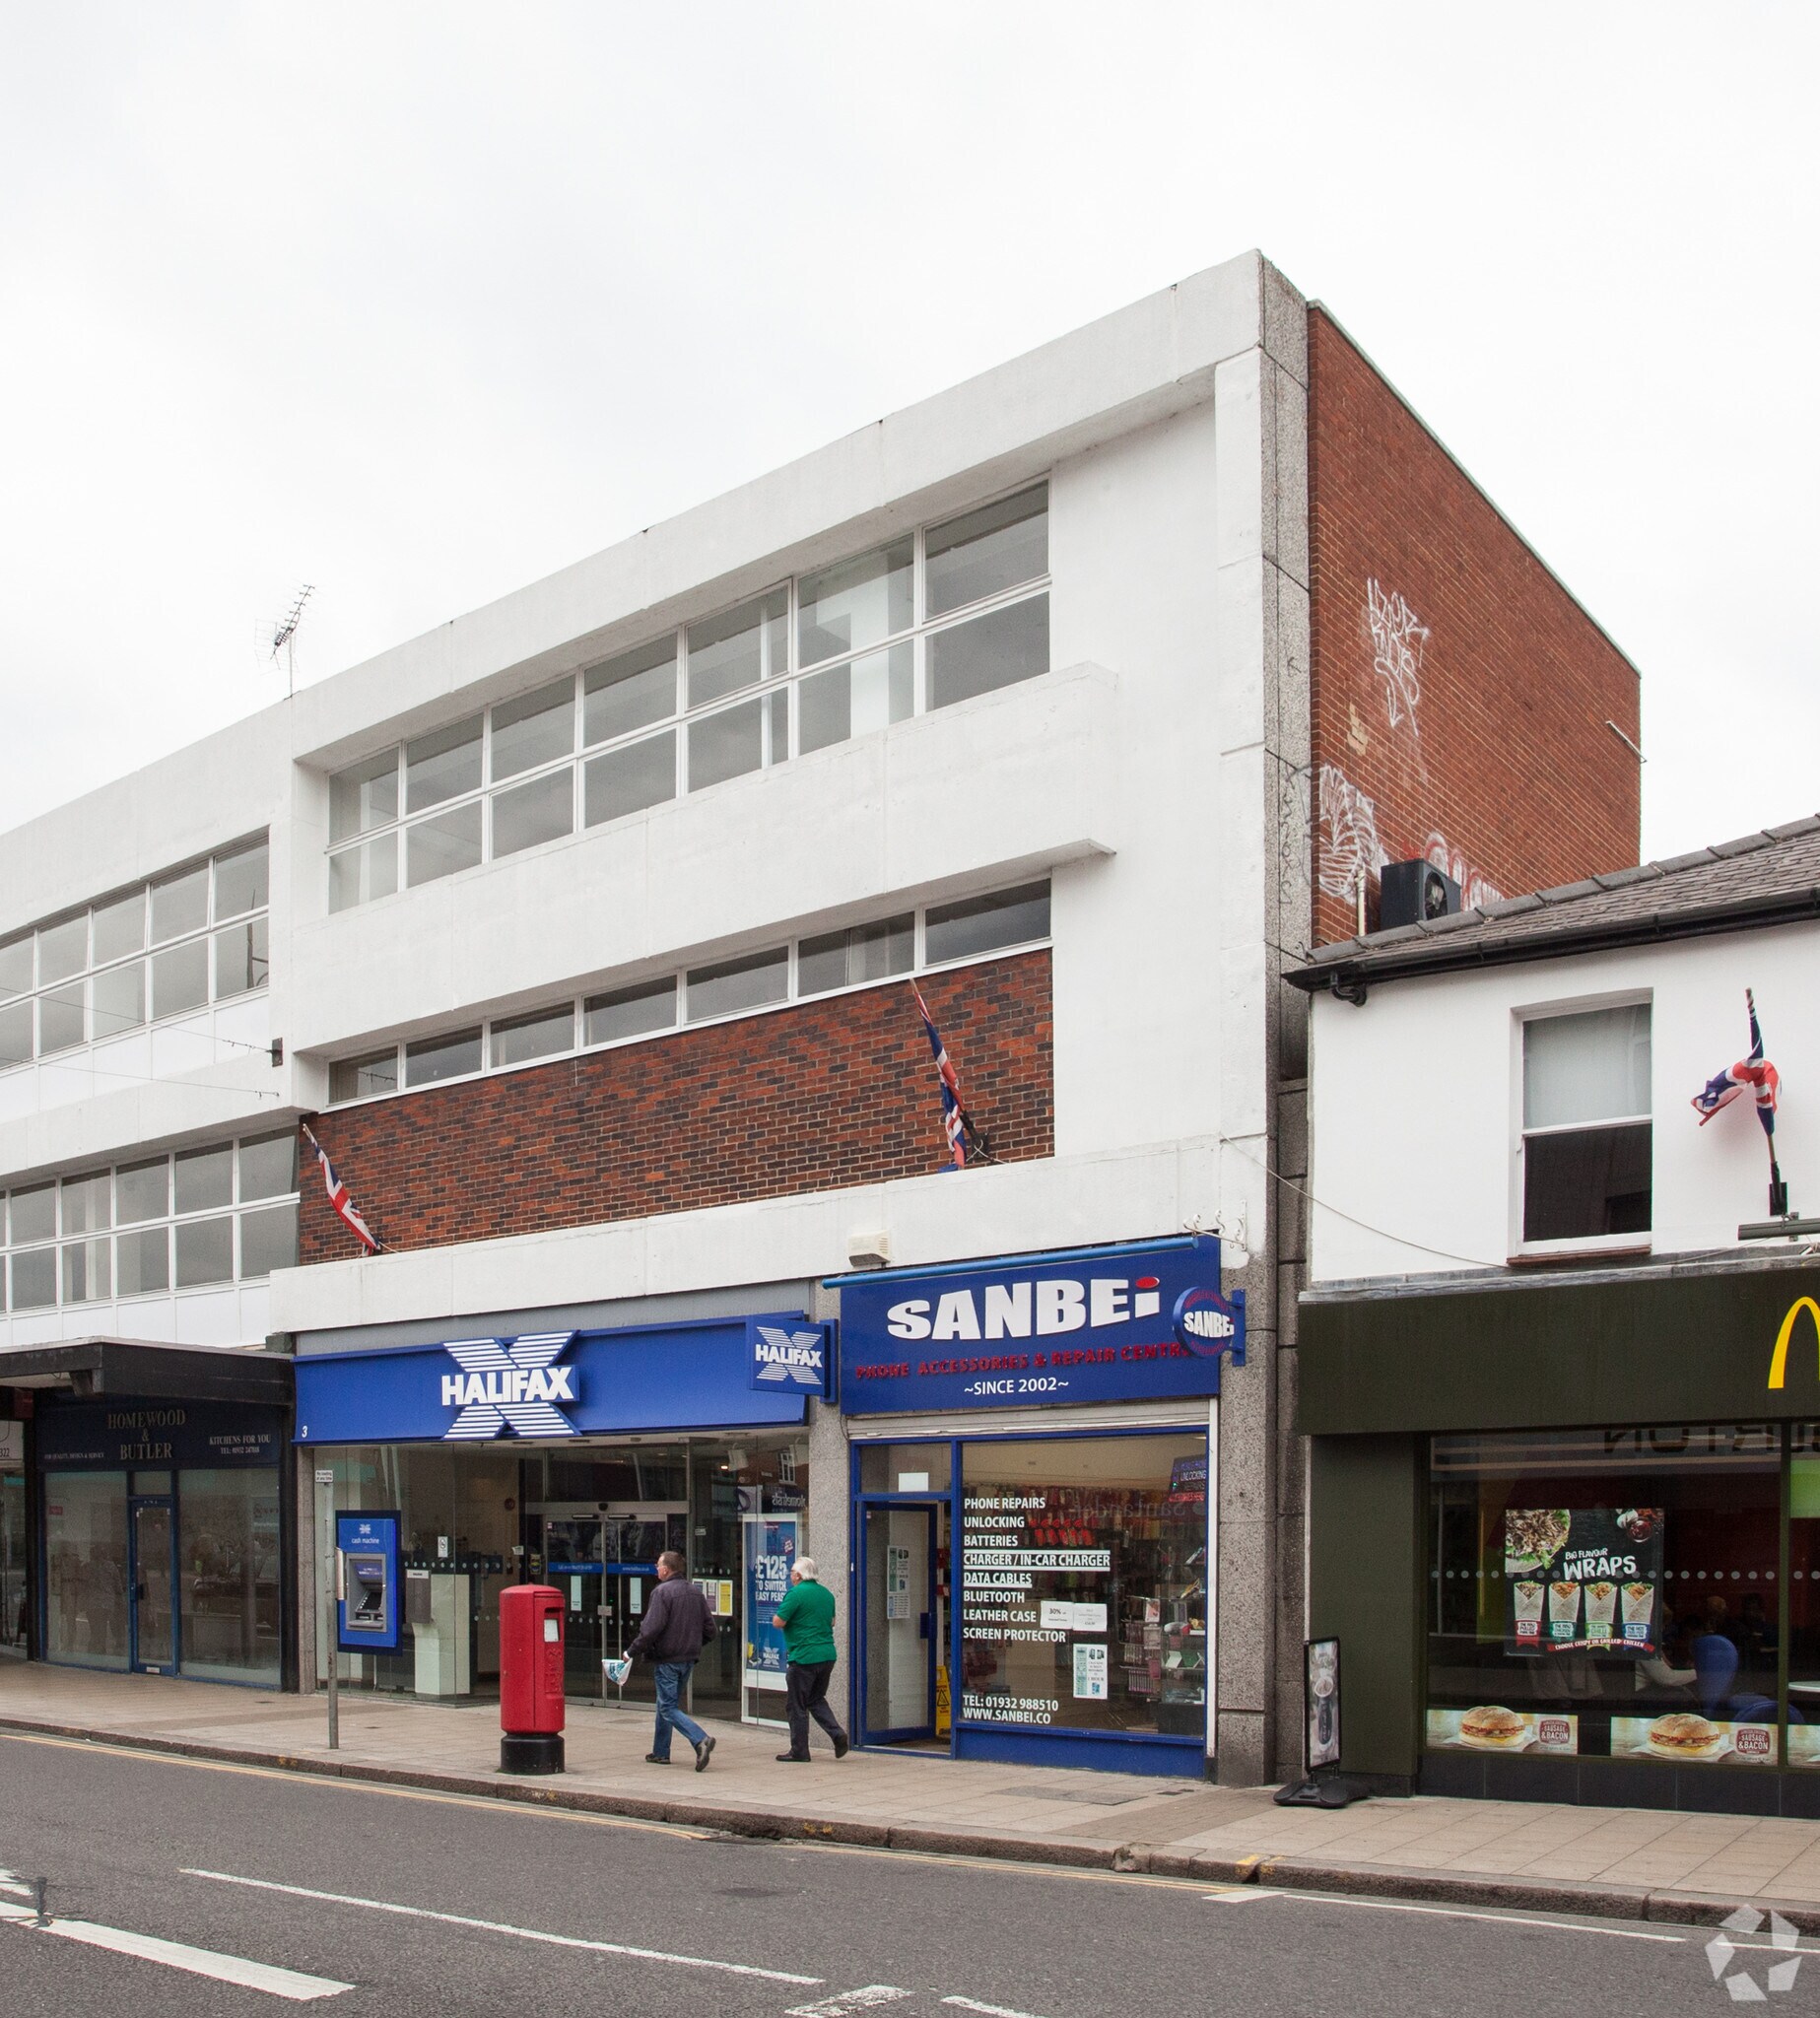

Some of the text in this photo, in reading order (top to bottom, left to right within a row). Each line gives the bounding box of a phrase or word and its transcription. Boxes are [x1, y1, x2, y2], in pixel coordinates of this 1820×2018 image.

[755, 1343, 823, 1368] HALIFAX
[855, 1362, 909, 1379] PHONE
[917, 1353, 1028, 1376] ACCESSORIES
[1034, 1353, 1046, 1367] &
[1050, 1348, 1114, 1367] REPAIR
[441, 1366, 574, 1406] HALIFAX
[107, 1408, 186, 1430] HOMEWOOD
[141, 1428, 150, 1443] &
[302, 1425, 308, 1438] 3
[209, 1434, 272, 1446] KITCHENS FOR YOU
[120, 1443, 172, 1460] BUTLER
[964, 1497, 1045, 1510] PHONE REPAIRS
[964, 1515, 1025, 1528] UNLOCKING
[964, 1534, 1018, 1547] BATTERIES
[964, 1554, 1111, 1567] CHARGER / IN-CAR CHARGER
[1565, 1547, 1608, 1561] BIG FLAVOUR
[1563, 1555, 1637, 1581] WRAPS
[755, 1580, 764, 1591] TO
[964, 1573, 1032, 1584] DATA CABLES
[755, 1590, 770, 1602] EASY
[964, 1590, 1025, 1603] BLUETOOTH
[964, 1609, 1037, 1623] LEATHER CASE
[963, 1627, 1066, 1643] SCREEN PROTECTOR
[963, 1694, 1059, 1712] TEL: 01932 988510
[963, 1708, 1051, 1724] WWW.SANBEI.CO
